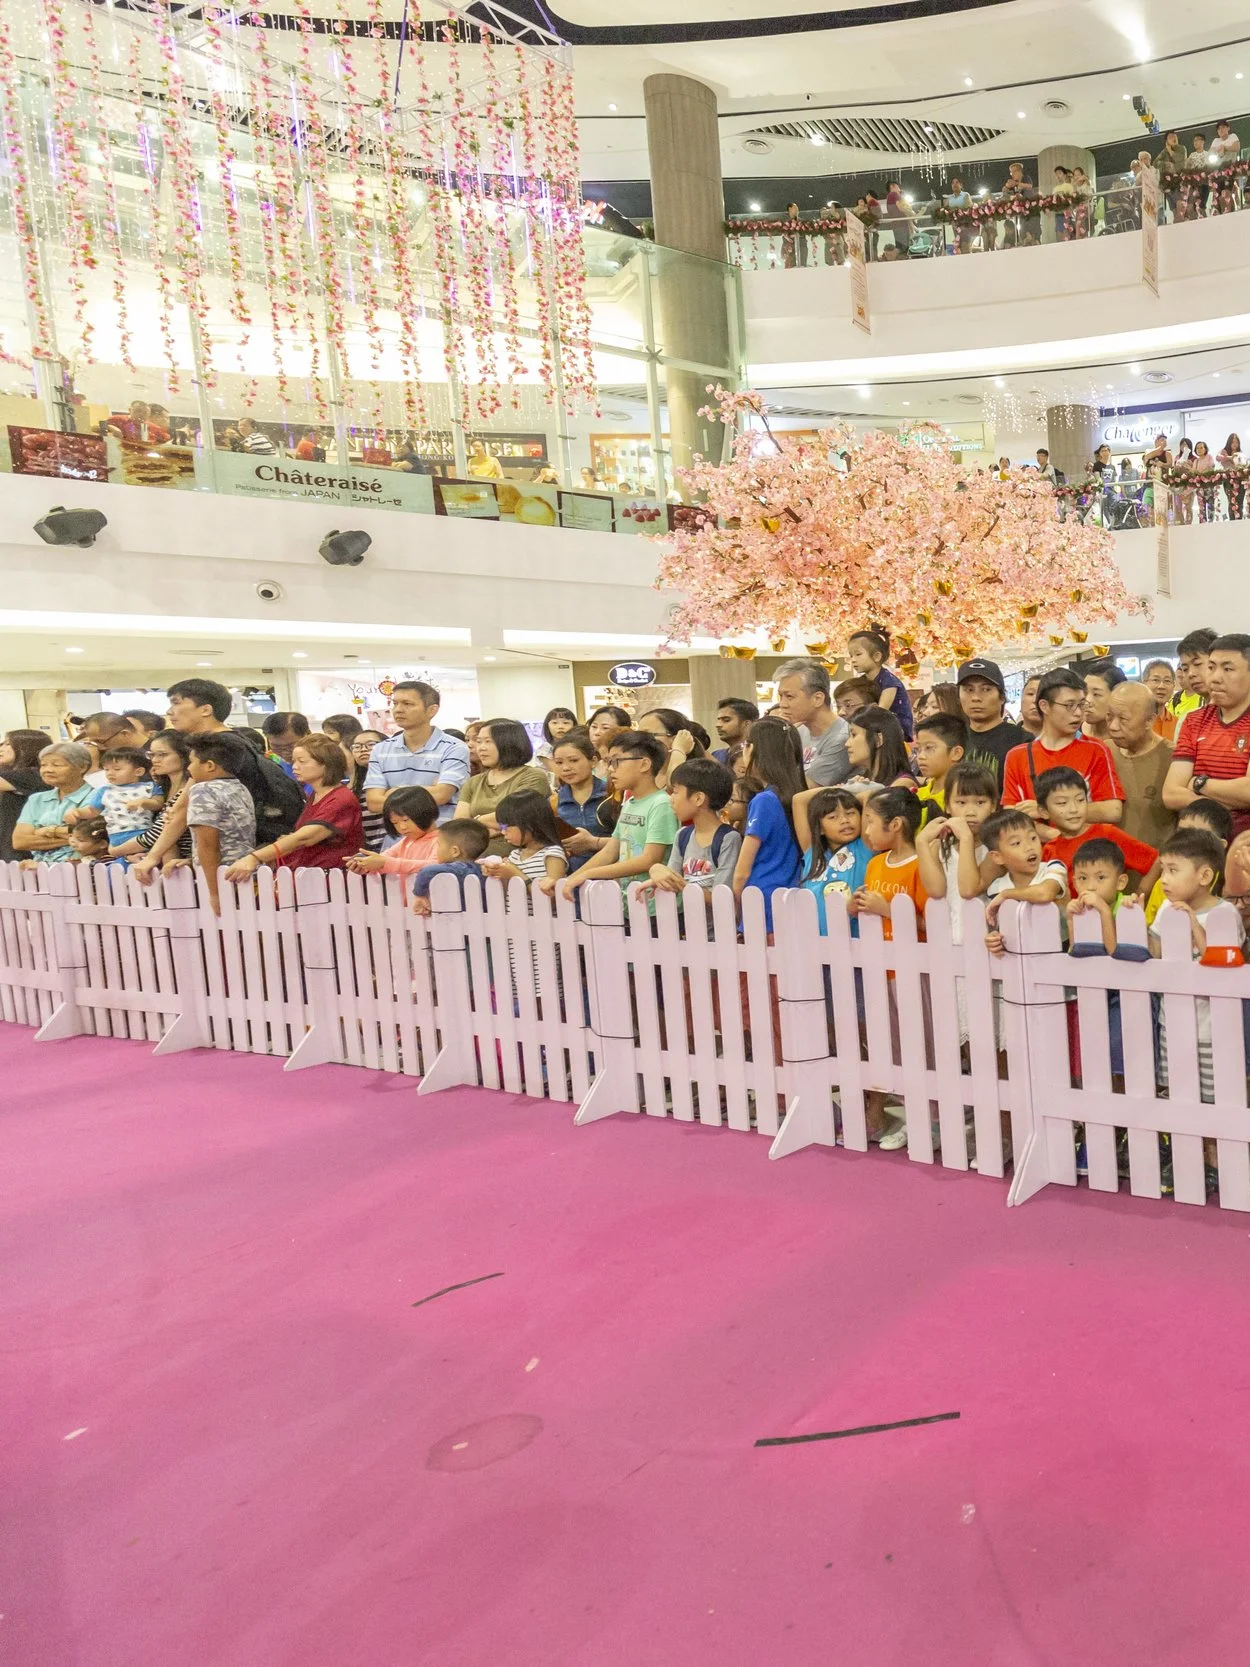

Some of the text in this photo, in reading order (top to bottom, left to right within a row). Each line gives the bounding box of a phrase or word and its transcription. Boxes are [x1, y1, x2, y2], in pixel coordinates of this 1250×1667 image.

[416, 439, 514, 456] PARISE
[255, 465, 383, 493] Châteraisé
[301, 489, 340, 500] JAPAN
